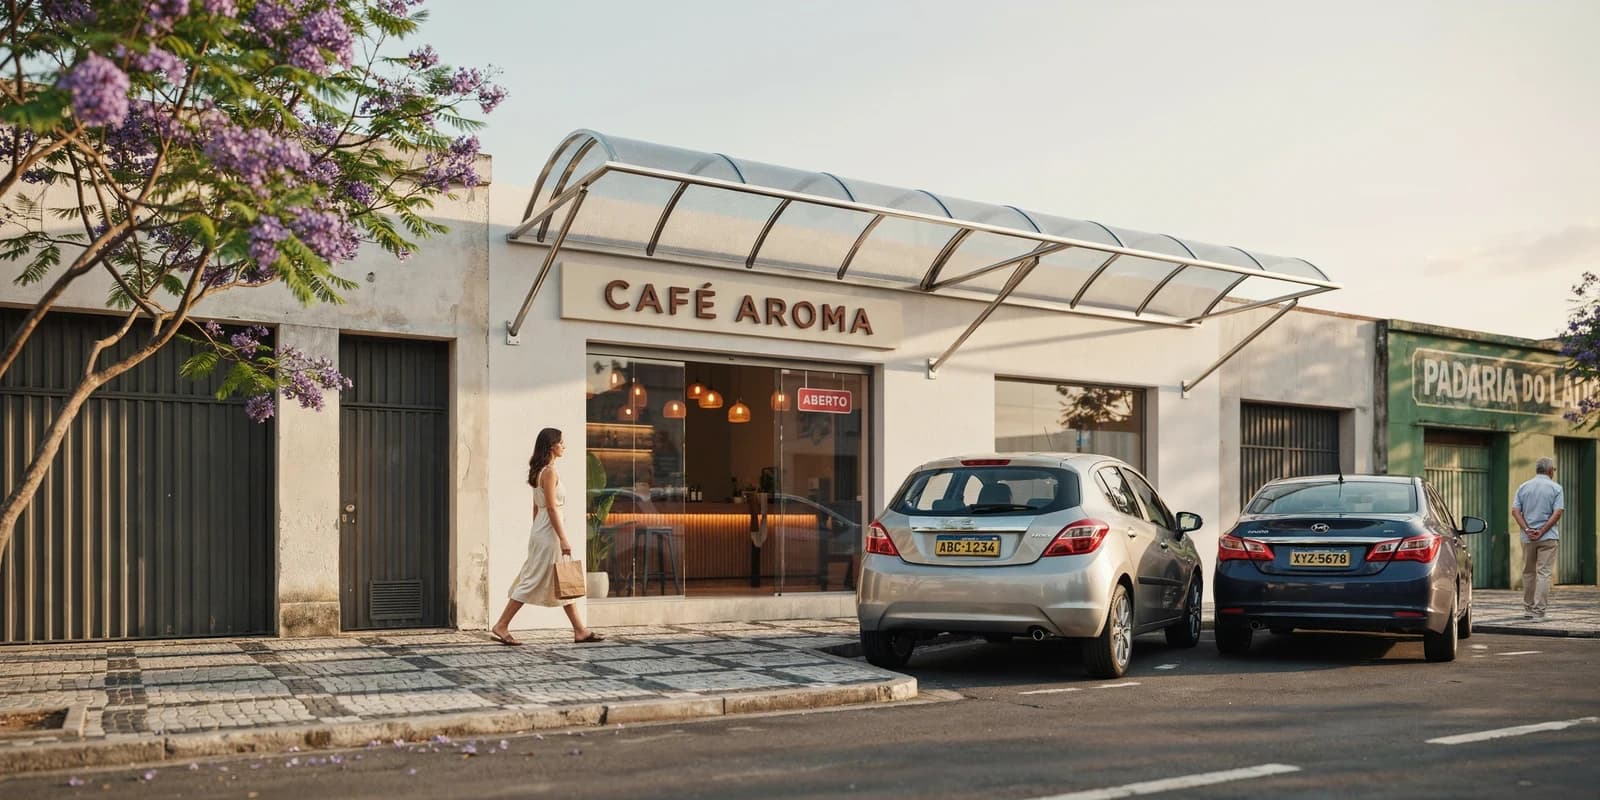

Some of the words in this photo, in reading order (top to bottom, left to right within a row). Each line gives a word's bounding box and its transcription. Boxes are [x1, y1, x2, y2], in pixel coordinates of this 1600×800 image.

[604, 280, 717, 319] CAFÉ
[735, 295, 874, 335] AROMA
[803, 394, 848, 407] ABERTO
[1424, 358, 1518, 404] PADARIA
[1522, 373, 1545, 404] DO
